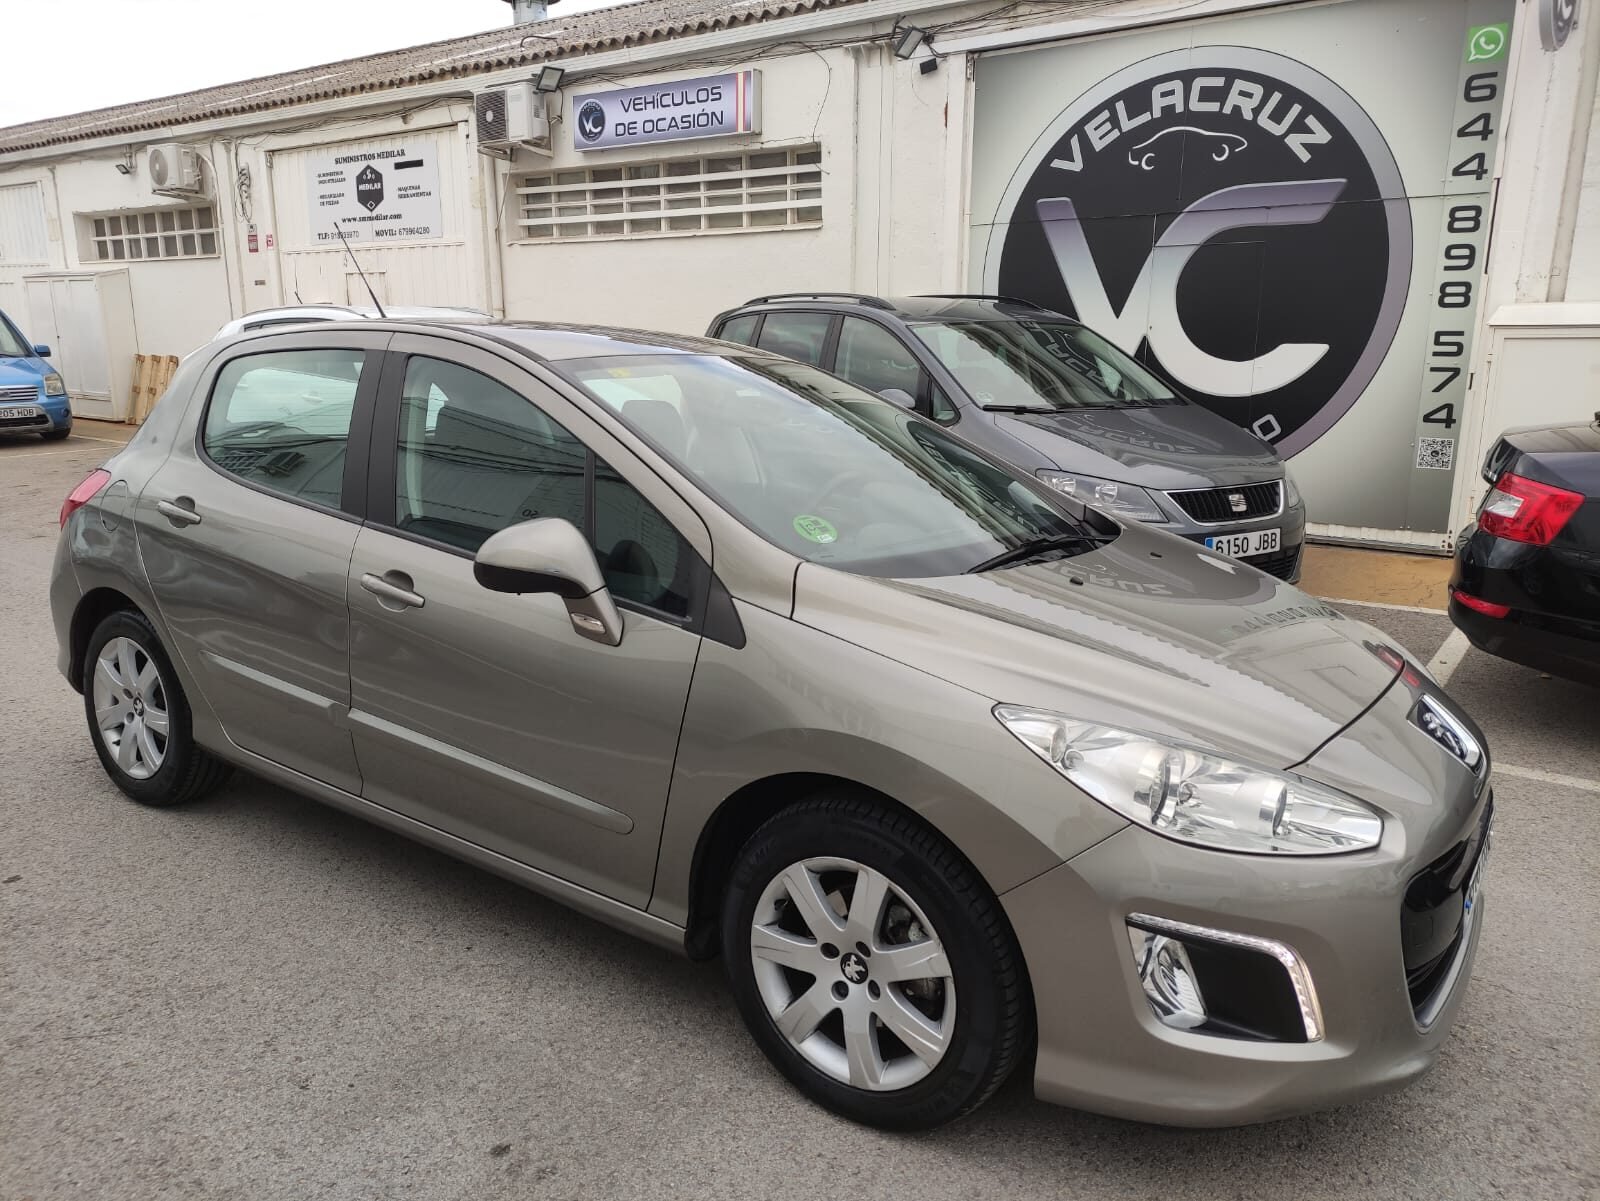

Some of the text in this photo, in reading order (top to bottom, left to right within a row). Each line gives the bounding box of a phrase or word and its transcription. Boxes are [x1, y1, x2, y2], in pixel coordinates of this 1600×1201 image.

[620, 86, 722, 113] VEHÍCULOS
[615, 109, 724, 137] DE OCASIÓN
[1050, 76, 1332, 172] VELACRUZ
[334, 149, 406, 165] SUMINISTROS MEDILAR
[358, 183, 381, 191] MEDILAR
[1036, 178, 1348, 397] VC
[1215, 532, 1277, 556] 6150 JBB
